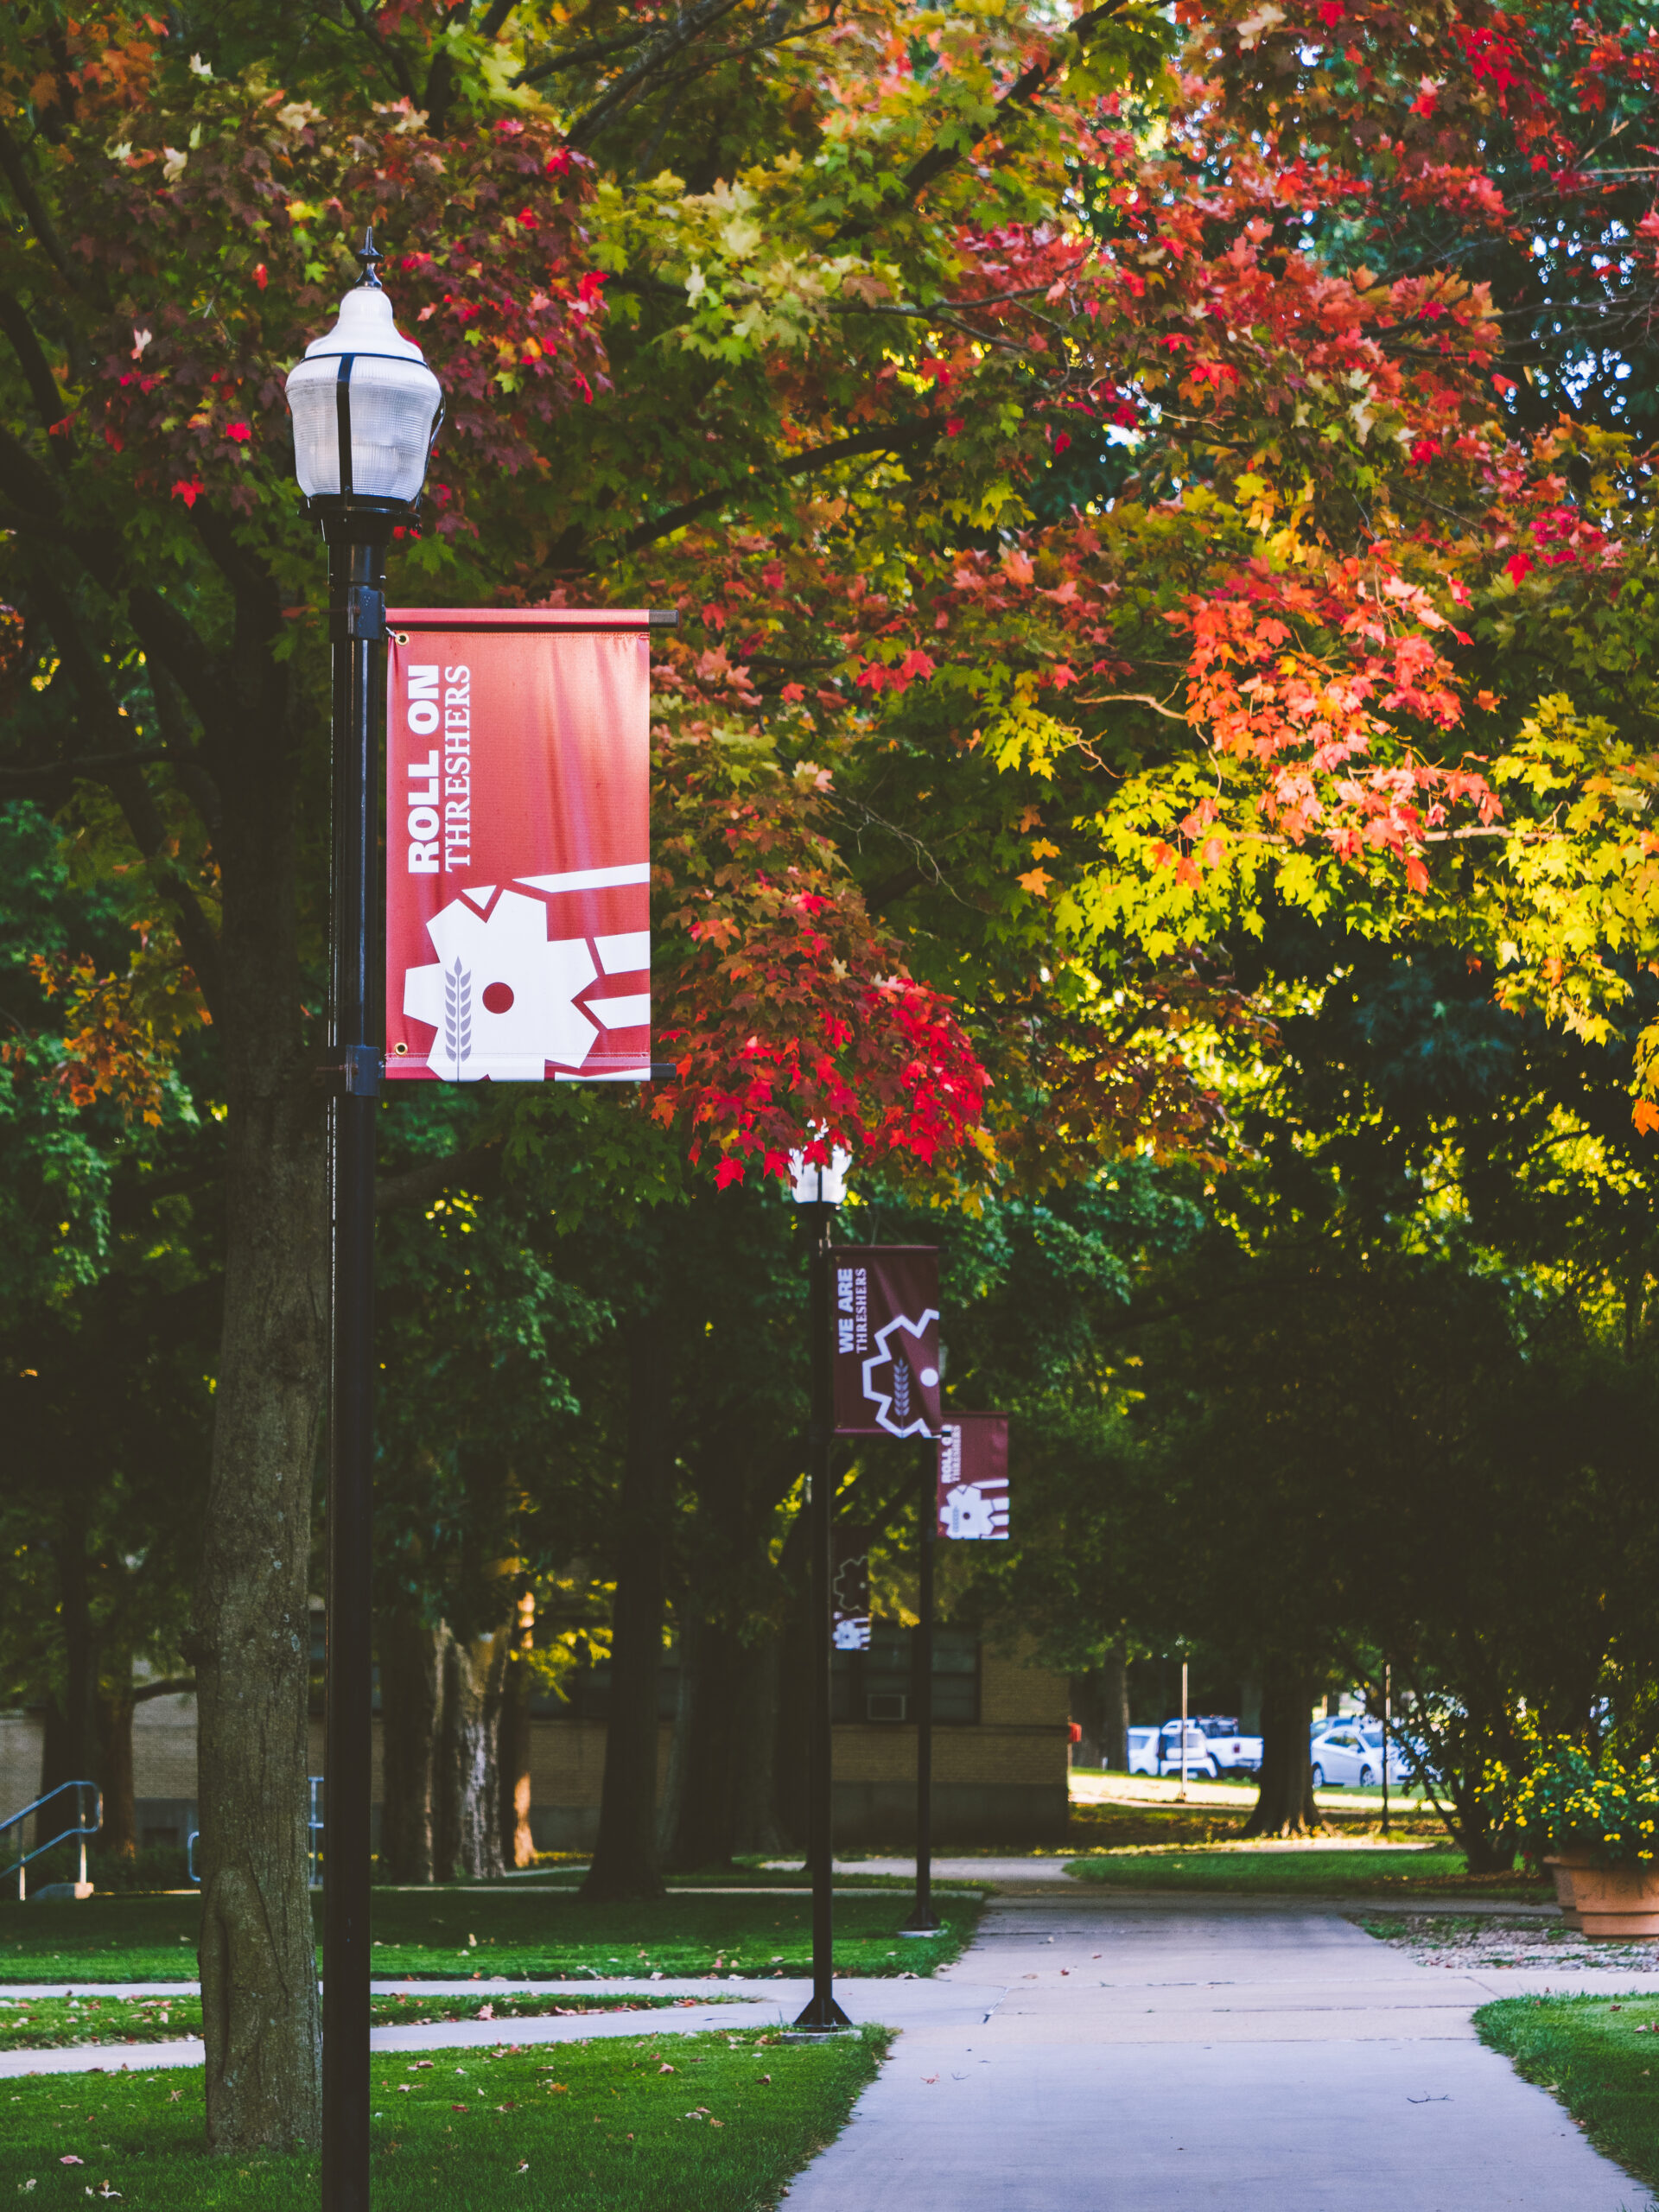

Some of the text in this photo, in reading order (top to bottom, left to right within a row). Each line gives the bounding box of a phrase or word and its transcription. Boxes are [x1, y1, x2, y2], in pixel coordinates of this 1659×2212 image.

[408, 664, 440, 873] ROLL ON
[444, 664, 471, 872] THRESHERS
[837, 1268, 854, 1354] WE ARE
[855, 1268, 868, 1354] THRESHERS
